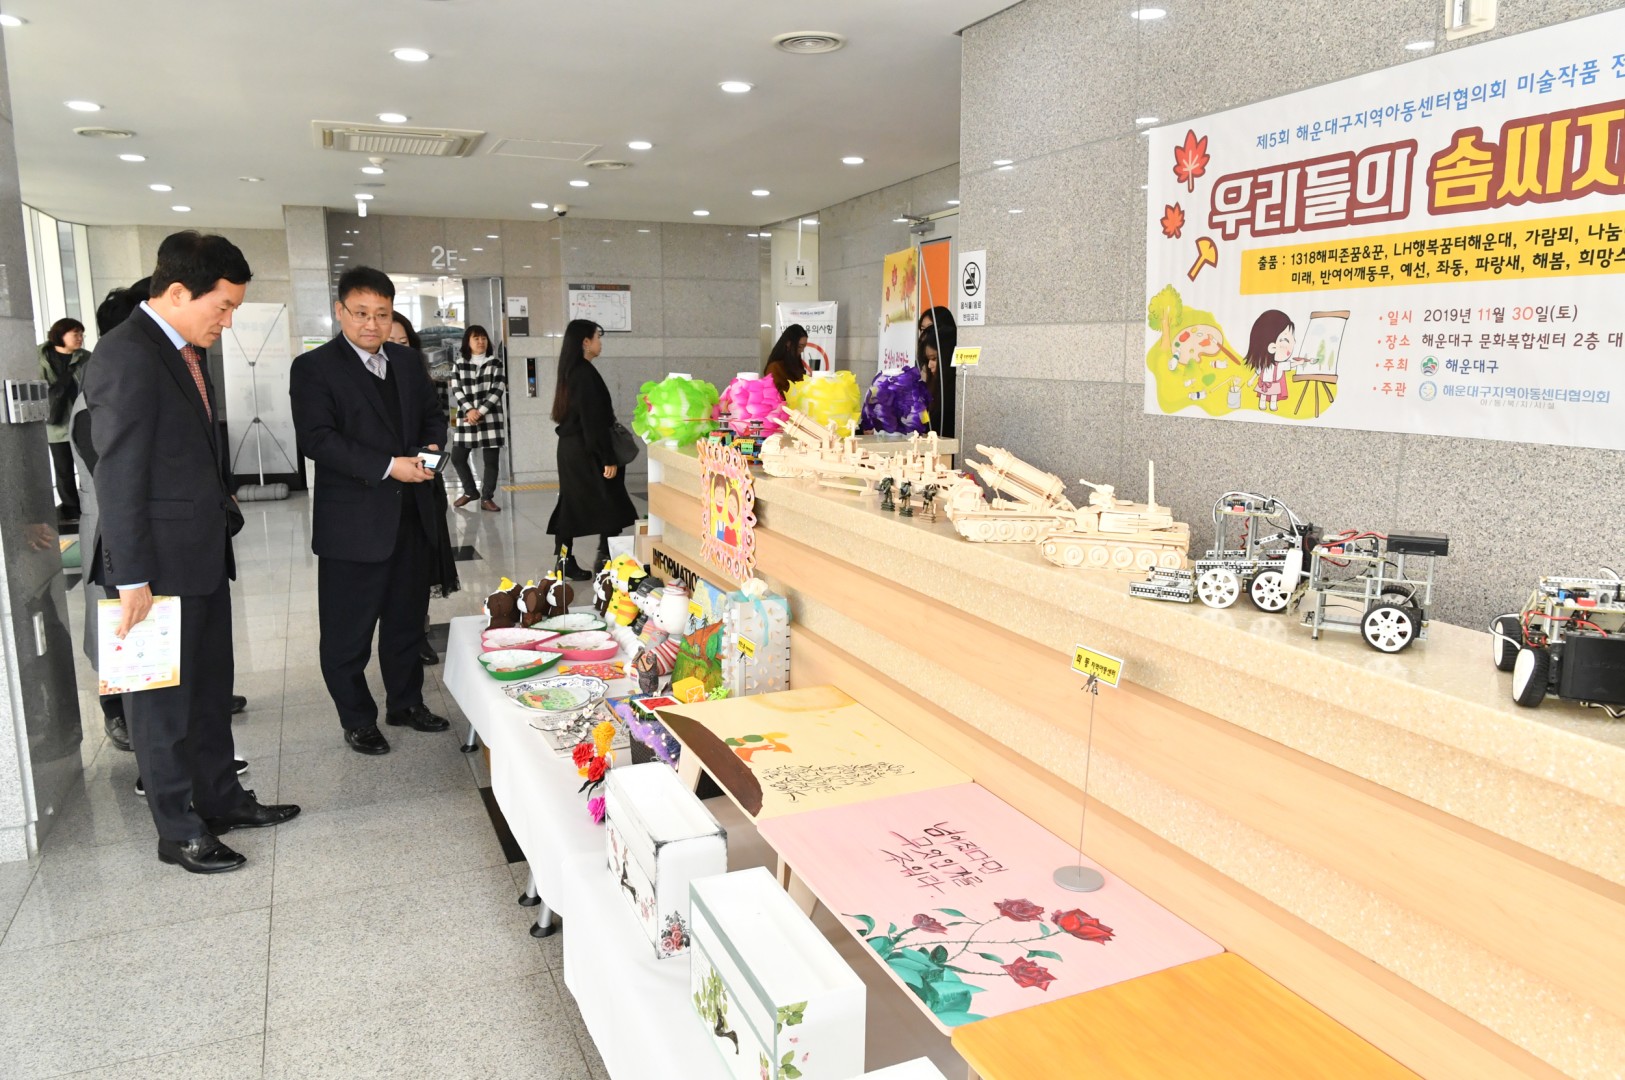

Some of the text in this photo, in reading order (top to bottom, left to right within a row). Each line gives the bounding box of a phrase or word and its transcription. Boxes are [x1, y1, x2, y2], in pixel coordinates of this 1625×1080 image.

[1256, 129, 1290, 149] 제5회
[1296, 79, 1507, 141] 해운대구지역아동센터협의회
[1517, 59, 1600, 94] 미술작품
[1210, 143, 1415, 238] 우리들의
[431, 245, 458, 267] 2F
[1257, 255, 1278, 271] 출품
[1290, 244, 1388, 266] 1318해피존꿈&꾼,
[1393, 231, 1518, 257] LH행복꿈터해운대,
[1525, 225, 1579, 247] 가람뫼,
[1587, 222, 1625, 242] 나눔
[1291, 271, 1315, 286] 미래,
[1320, 265, 1394, 285] 반여어깨동무,
[1400, 261, 1430, 279] 예선,
[1436, 258, 1468, 277] 좌동,
[1475, 254, 1525, 275] 파랑새,
[1532, 251, 1570, 271] 해봄,
[1387, 304, 1578, 326] 일시 2019년 11월 30일(토)
[1385, 334, 1410, 350] 장소
[1421, 333, 1473, 349] 해운대구
[1478, 332, 1566, 350] 문화복합센터
[1573, 331, 1600, 351] 2층
[1383, 358, 1499, 375] 주최 해운대구
[1381, 382, 1611, 403] 주관 해운대구지역아동센터협의회
[652, 547, 702, 588] INFORMATIO
